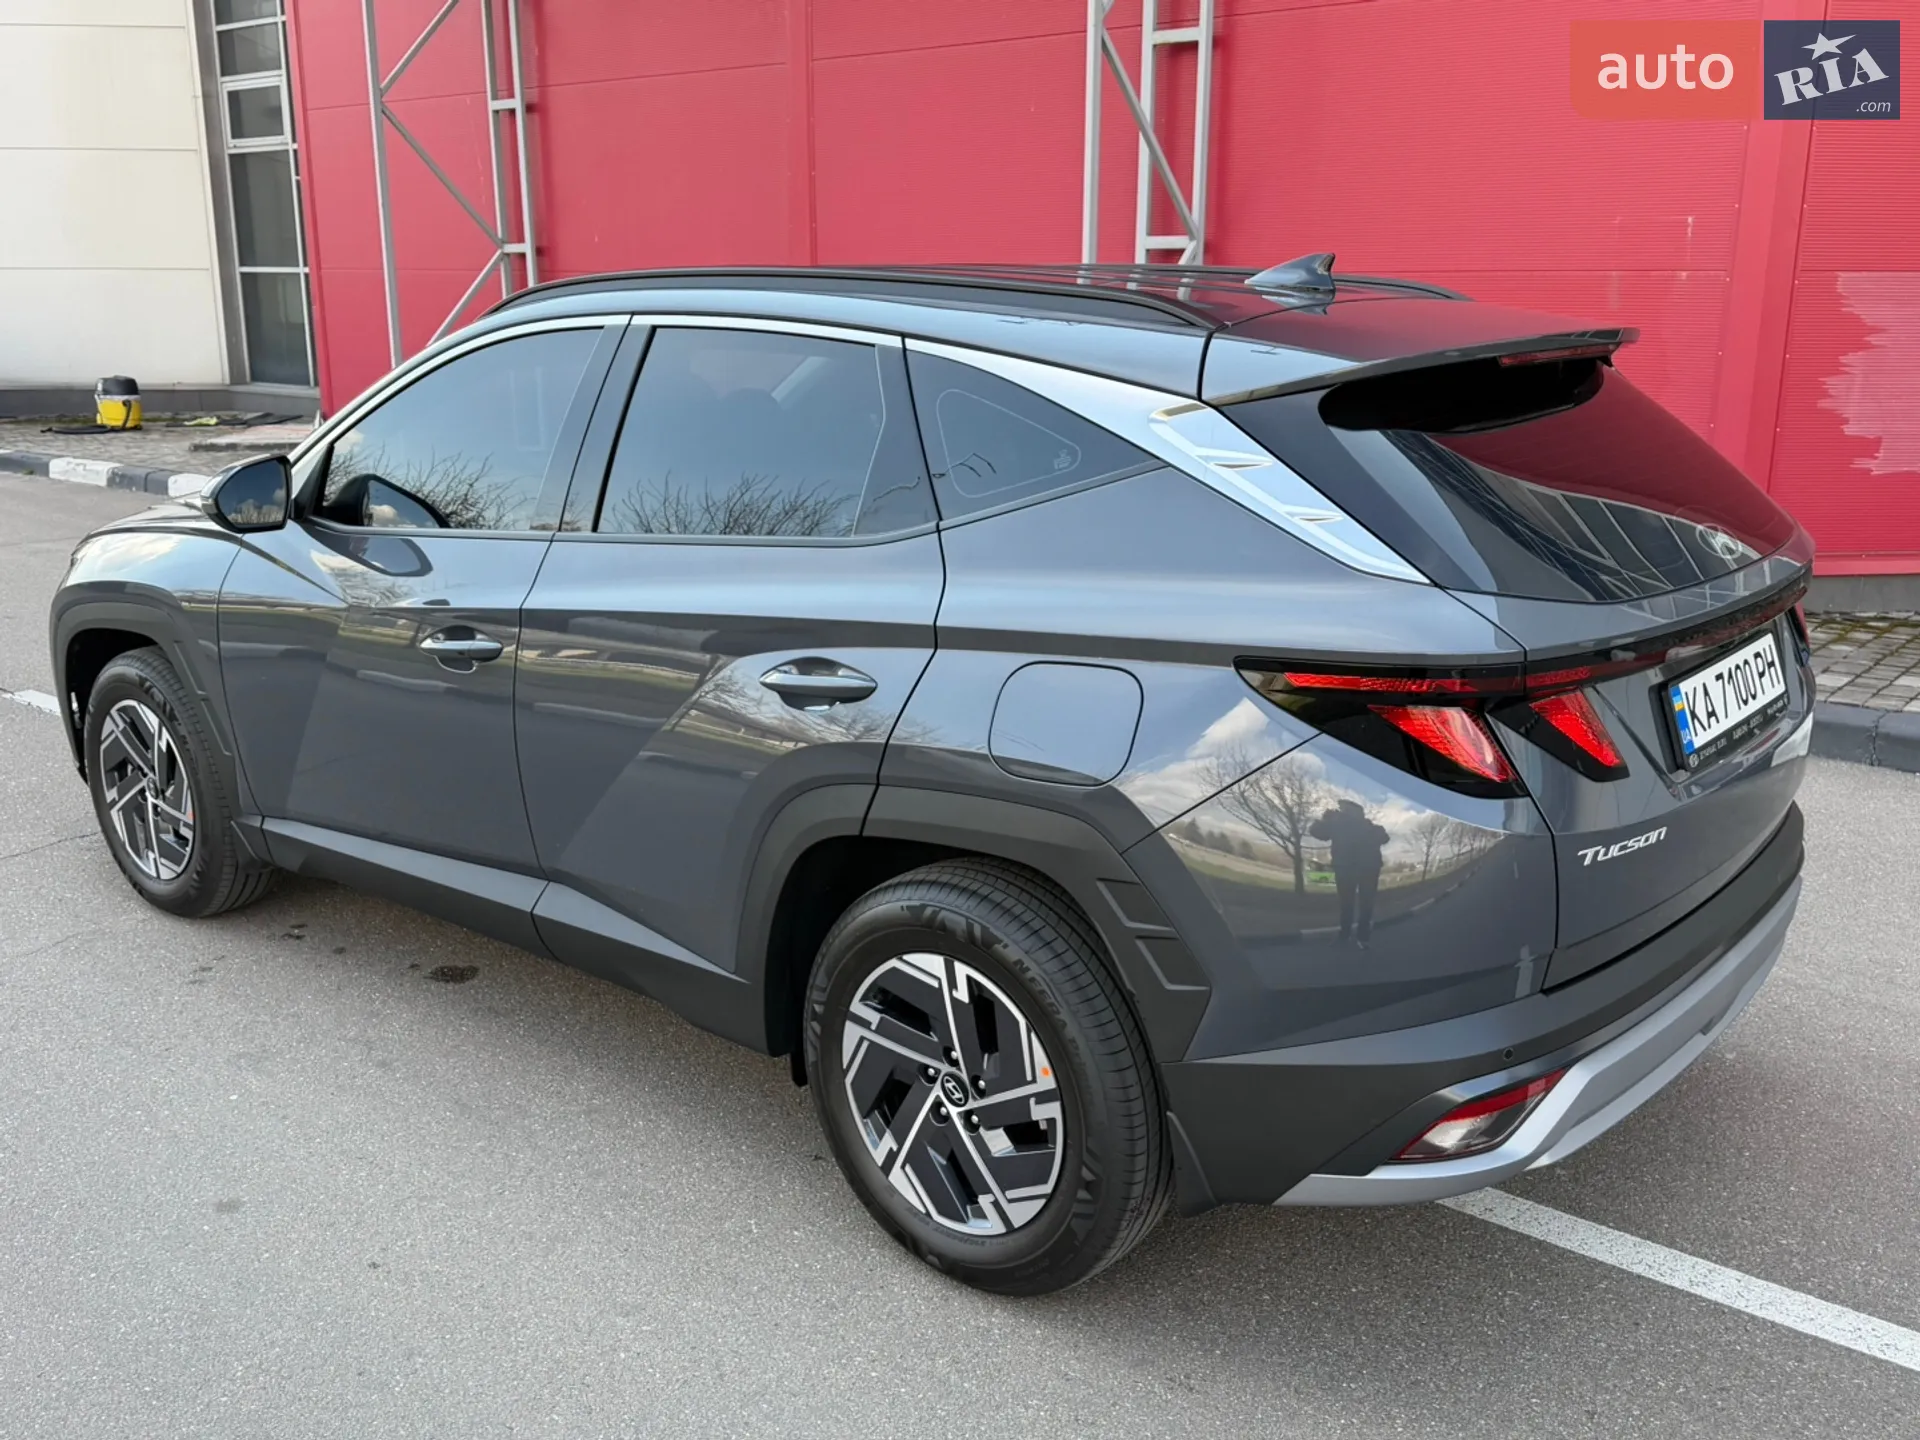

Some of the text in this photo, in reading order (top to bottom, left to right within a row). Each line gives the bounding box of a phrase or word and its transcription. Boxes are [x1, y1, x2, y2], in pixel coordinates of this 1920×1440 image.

[1685, 682, 1720, 737] KA
[1714, 658, 1758, 720] 7100
[1753, 643, 1781, 696] PH
